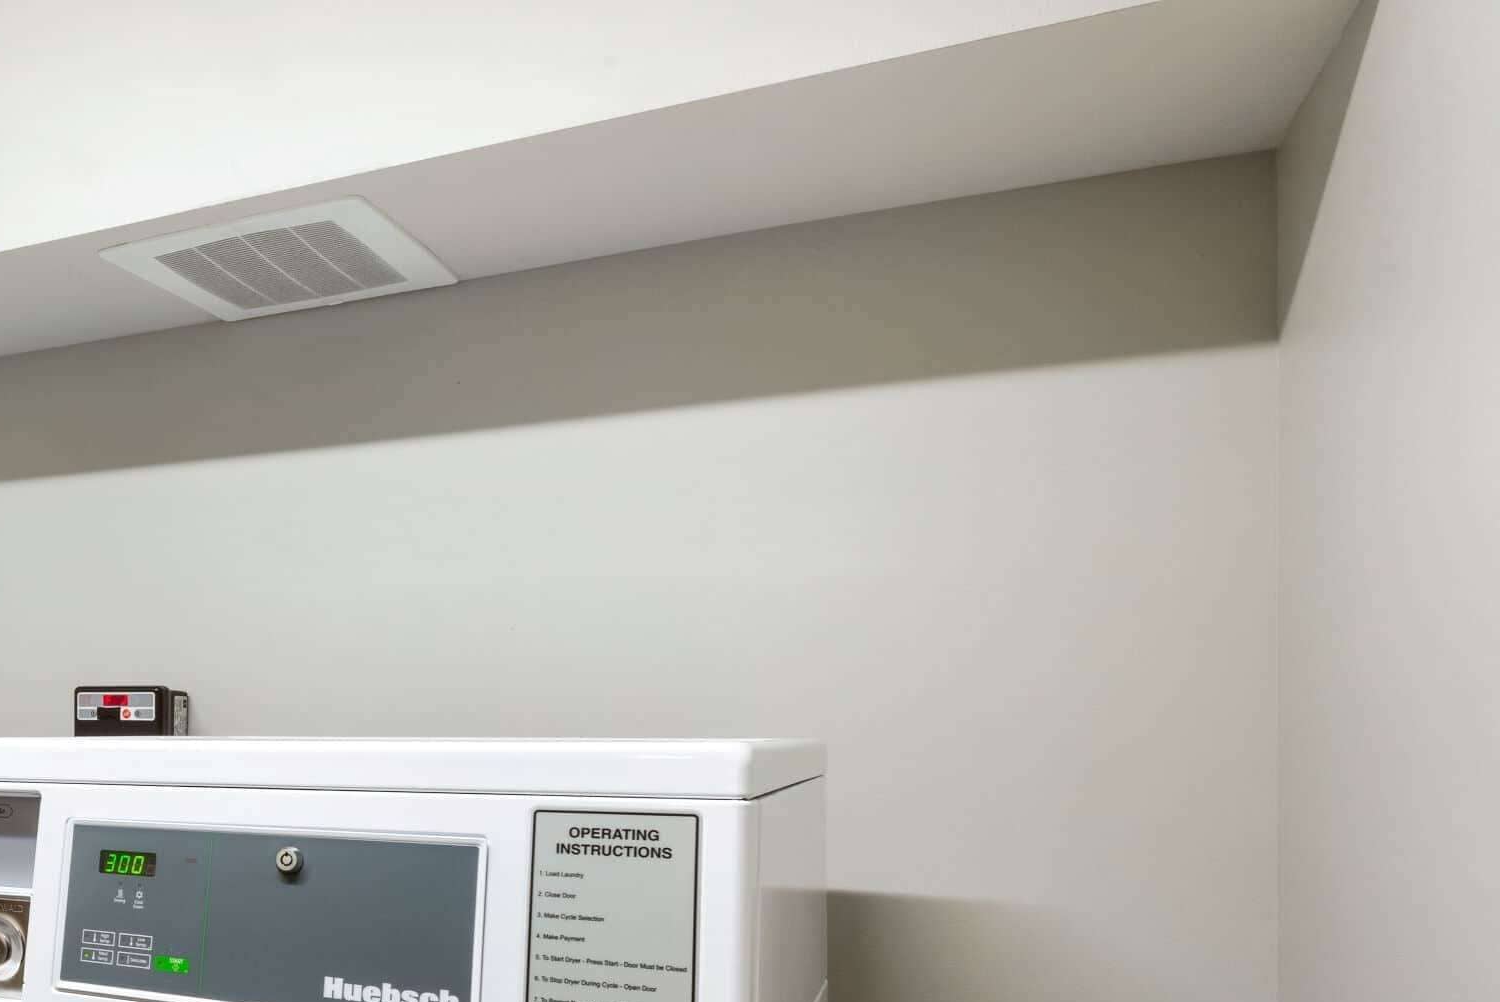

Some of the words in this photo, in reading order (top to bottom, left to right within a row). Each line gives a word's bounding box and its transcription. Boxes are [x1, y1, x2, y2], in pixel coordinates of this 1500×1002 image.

[568, 826, 661, 842] OPERATING
[555, 843, 673, 860] INSTRUCTIONS
[104, 853, 145, 875] 300
[545, 870, 560, 878] Load
[561, 871, 584, 880] Laundry
[562, 892, 576, 900] Door
[543, 912, 560, 920] Make
[560, 913, 577, 922] Cycle
[578, 914, 605, 923] Selection
[542, 933, 559, 941] Make
[559, 934, 586, 944] Payment
[565, 956, 581, 965] Dryer
[623, 961, 639, 969] Door
[665, 964, 688, 973] Closed
[563, 977, 580, 986] Dryer
[581, 979, 601, 989] During
[623, 983, 641, 992] Open
